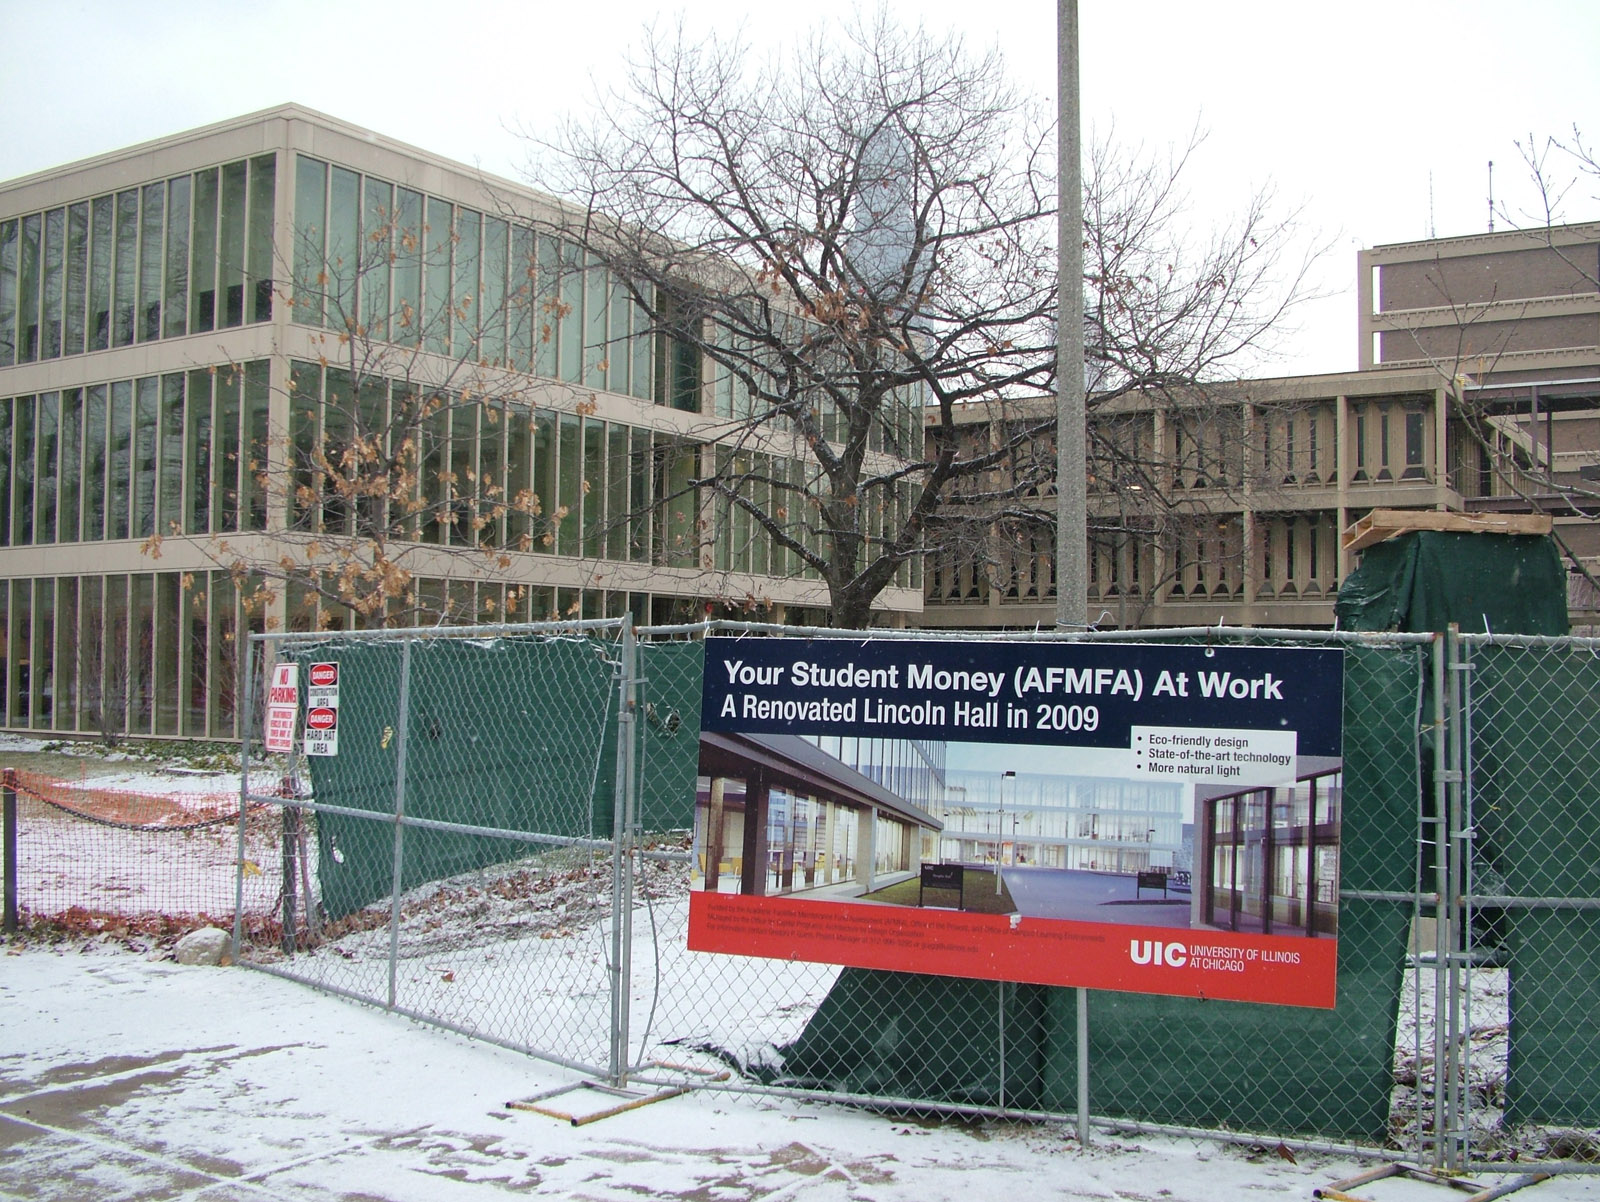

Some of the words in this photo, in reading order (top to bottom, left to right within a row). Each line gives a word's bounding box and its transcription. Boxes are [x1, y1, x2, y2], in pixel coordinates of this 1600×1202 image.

[280, 668, 289, 685] NO
[312, 670, 335, 680] DANGER
[723, 660, 784, 686] Your
[791, 661, 899, 689] Student
[907, 664, 1006, 697] Money
[1014, 666, 1144, 702] (AFMFA)
[1152, 670, 1189, 697] At
[1198, 671, 1284, 700] Work
[270, 687, 297, 703] PARKING
[310, 714, 334, 724] DANGER
[720, 694, 737, 718] A
[743, 694, 857, 723] Renovated
[864, 698, 946, 726] Lincoln
[954, 701, 998, 728] Hall
[1007, 702, 1028, 729] in
[1036, 704, 1100, 732] 2009
[306, 730, 322, 741] HARD
[323, 730, 336, 741] HAT
[1149, 734, 1212, 747] Eco-friendly
[1214, 737, 1249, 749] design
[312, 743, 329, 754] AREA
[1148, 748, 1231, 762] State-of-the-art
[1233, 751, 1292, 766] technology
[1148, 762, 1175, 774] More
[1177, 764, 1214, 775] natural
[1217, 765, 1241, 777] light
[1130, 939, 1187, 967] UIC
[1190, 945, 1244, 959] UNIVERSITY
[1246, 948, 1258, 961] OF
[1261, 950, 1301, 964] ILLINOIS
[1190, 957, 1201, 968] AT
[1202, 958, 1245, 972] CHICAGO
